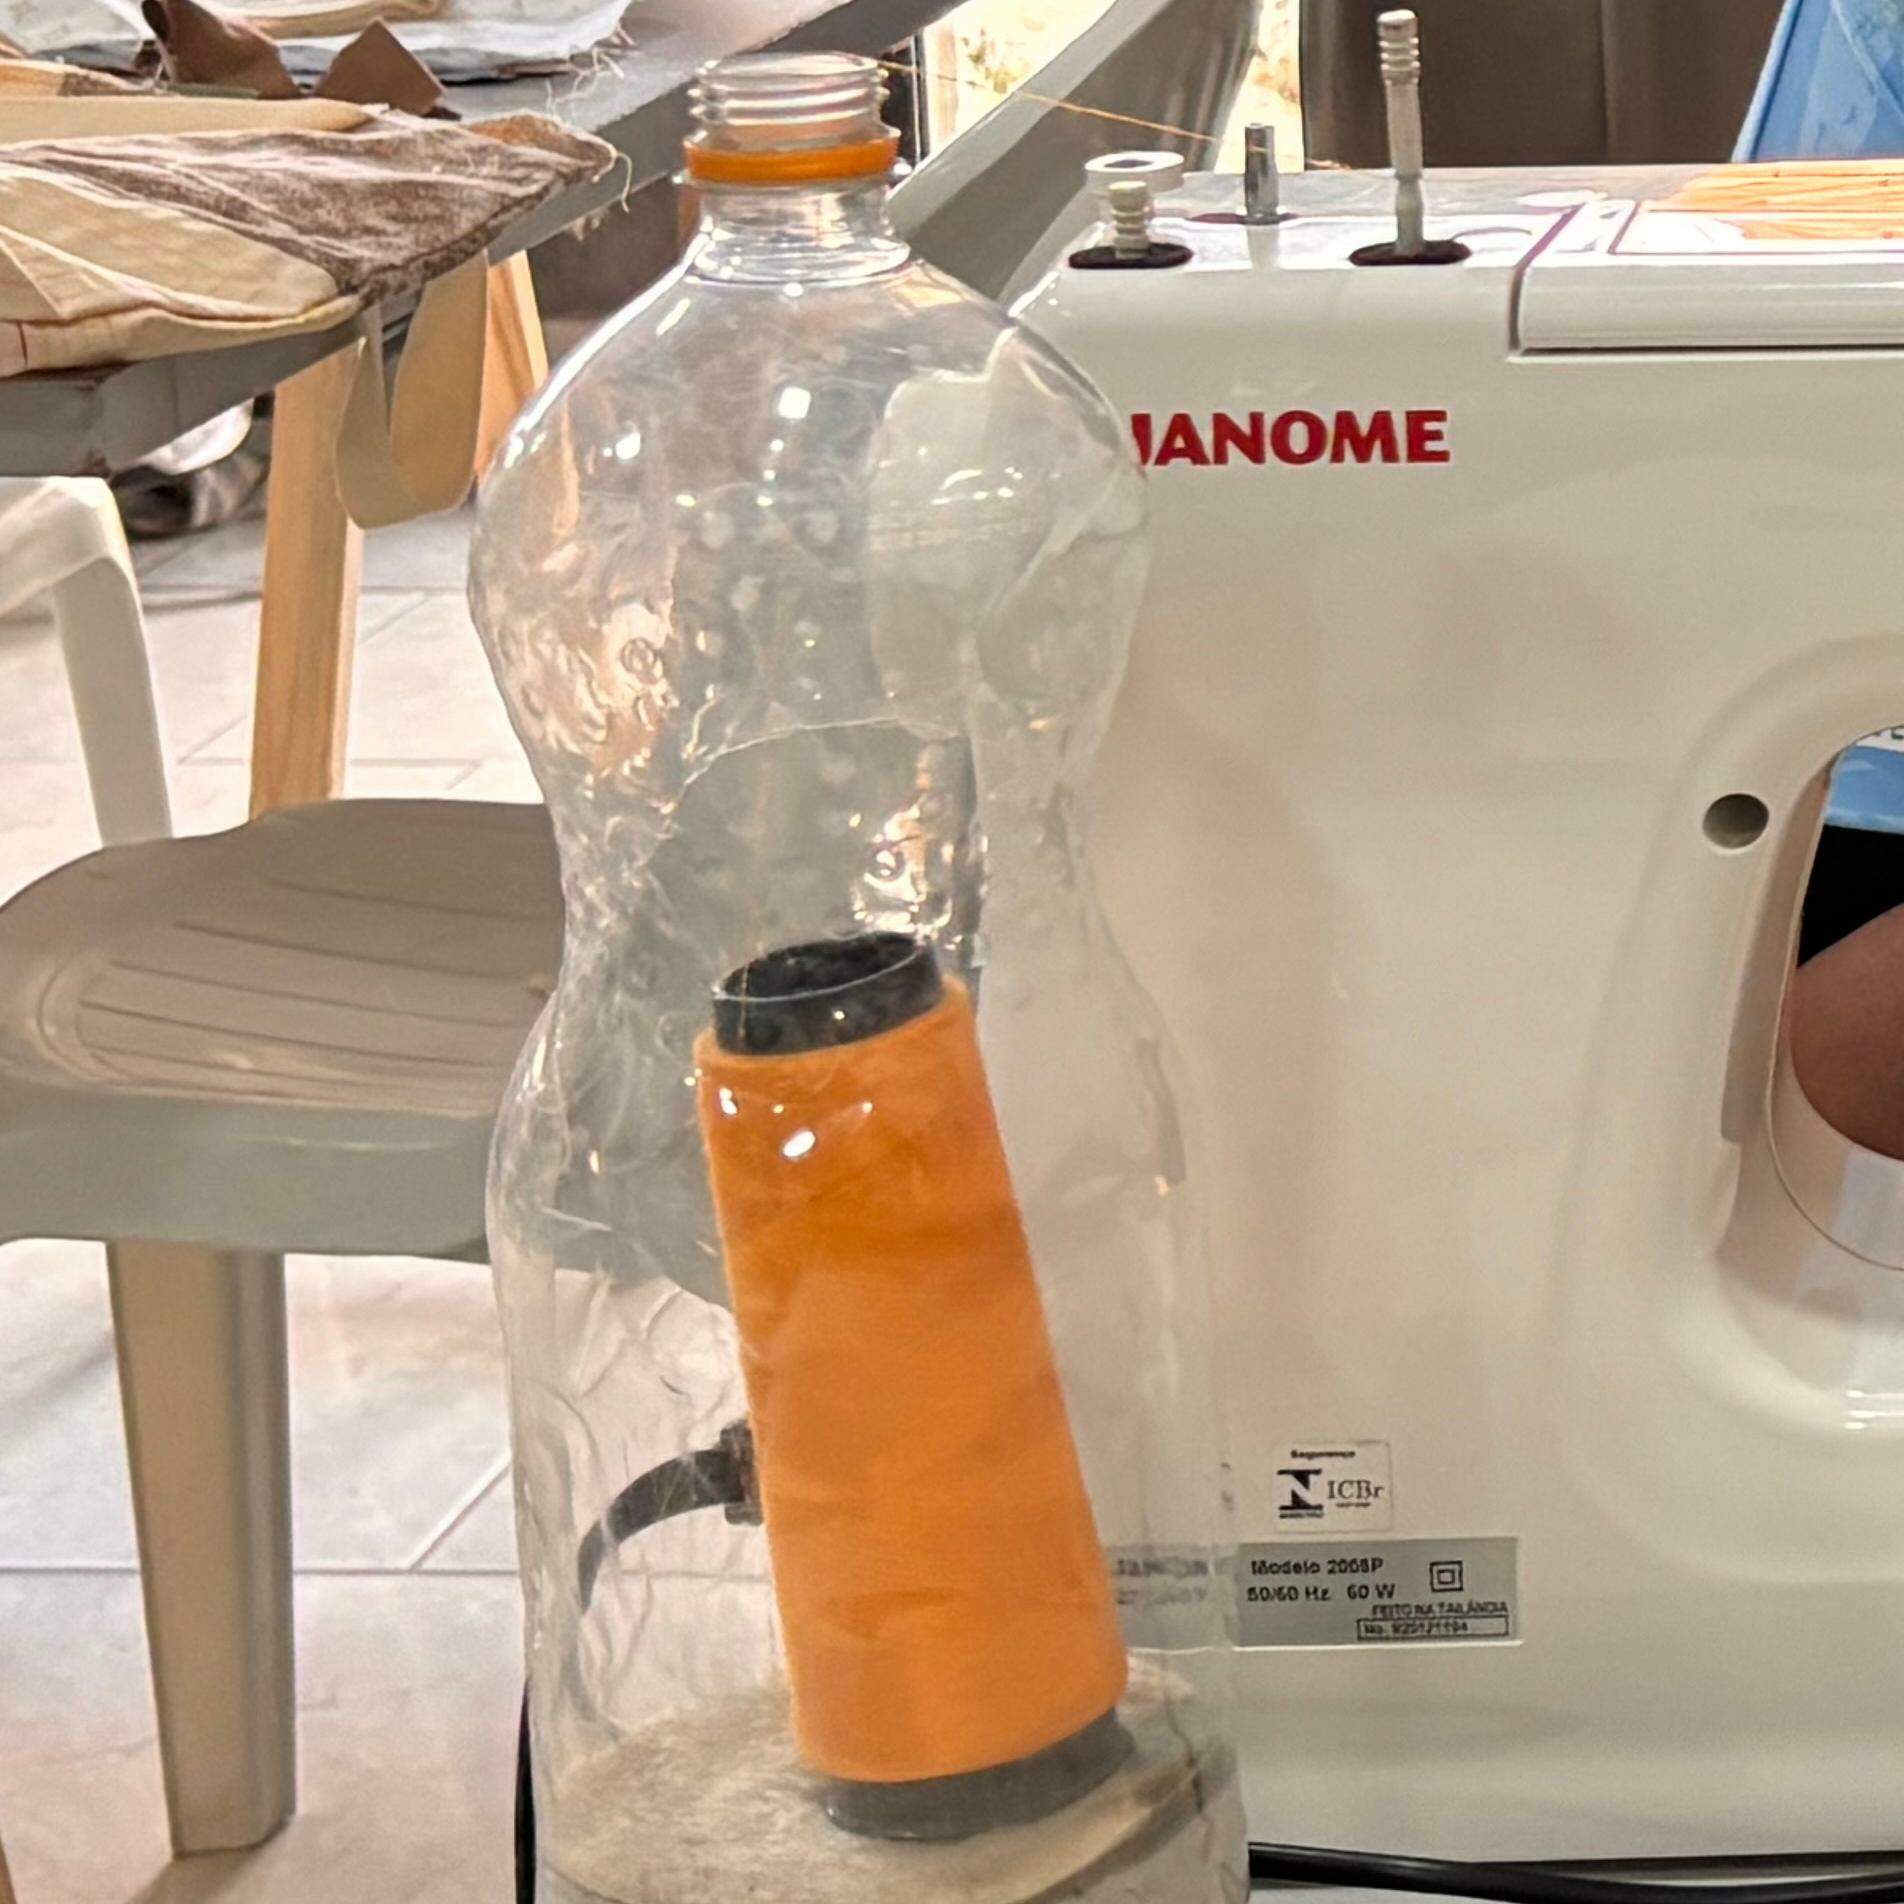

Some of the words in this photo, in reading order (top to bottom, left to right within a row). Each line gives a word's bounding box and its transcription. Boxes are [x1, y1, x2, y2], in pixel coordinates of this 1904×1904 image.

[1251, 1559, 1321, 1575] Modelo
[1347, 1583, 1370, 1599] 60
[1375, 1582, 1396, 1598] W
